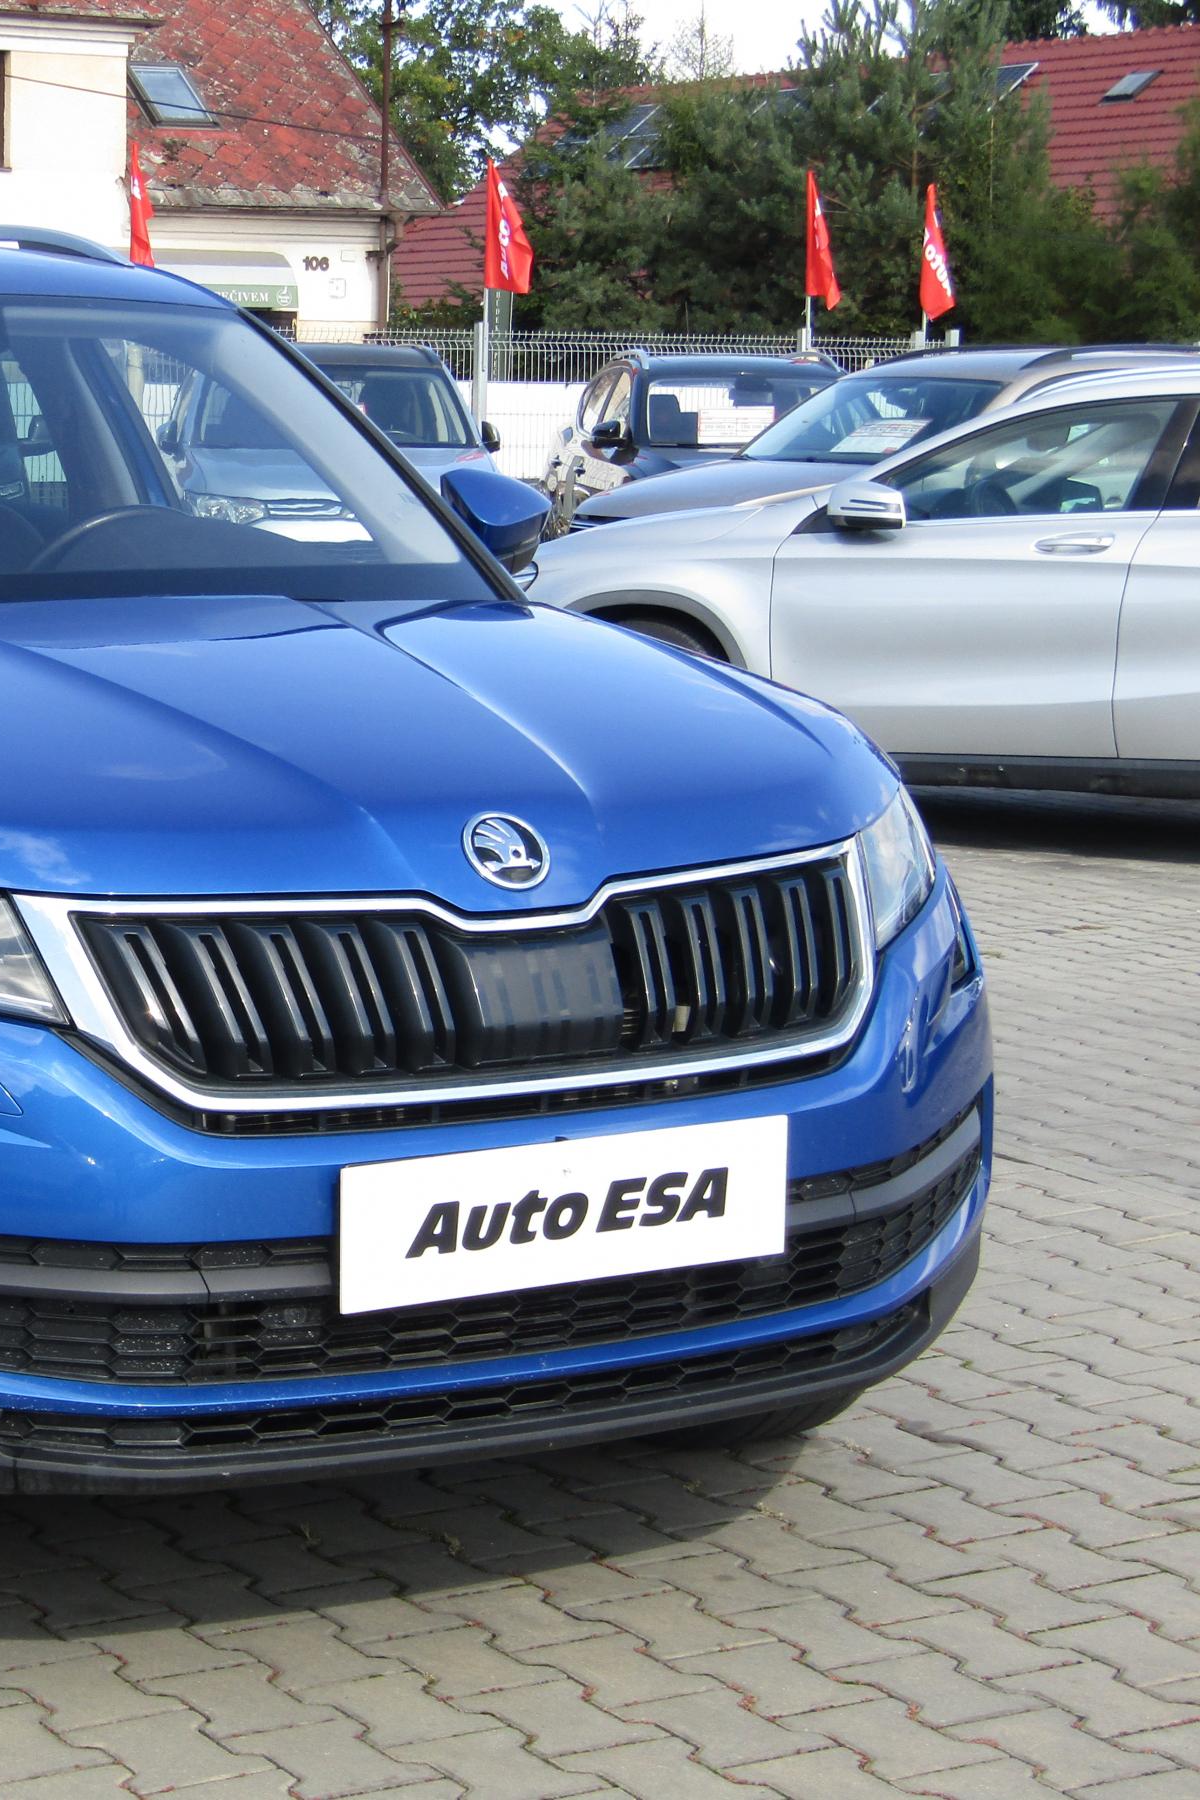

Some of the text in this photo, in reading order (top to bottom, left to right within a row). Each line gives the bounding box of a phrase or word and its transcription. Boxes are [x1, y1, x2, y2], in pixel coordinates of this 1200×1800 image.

[302, 256, 330, 272] 106
[405, 1167, 729, 1259] Auto ESA
